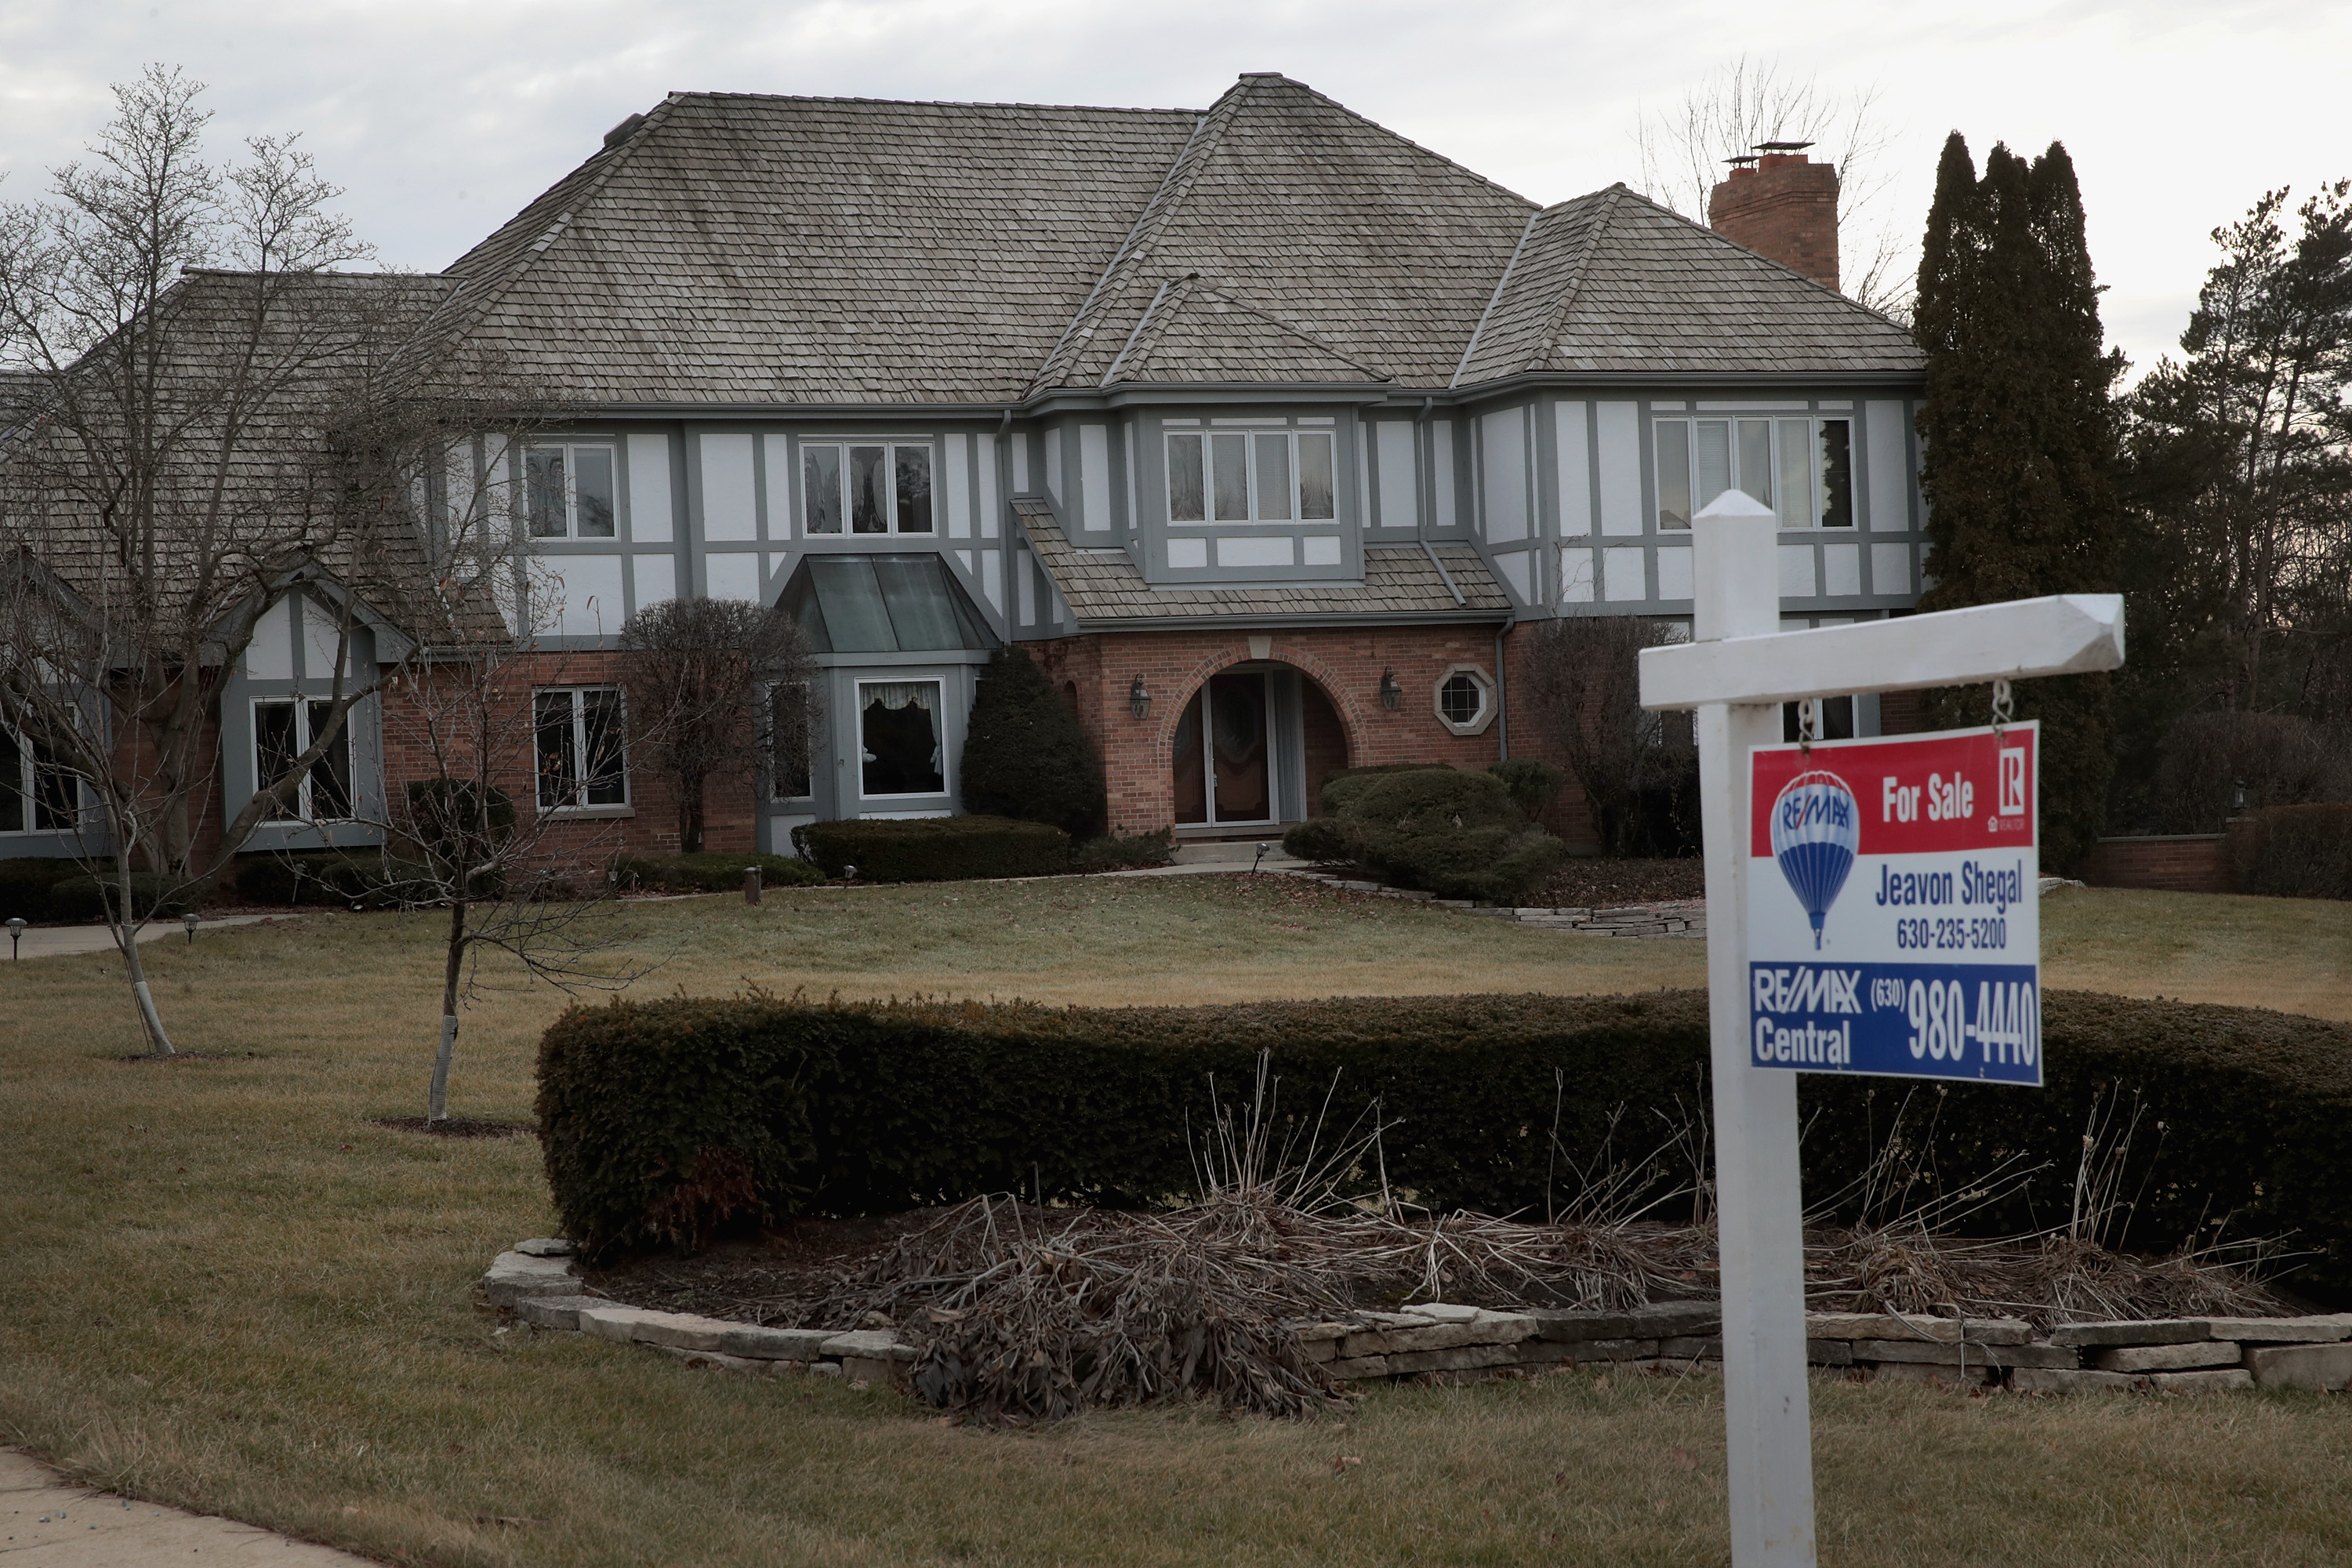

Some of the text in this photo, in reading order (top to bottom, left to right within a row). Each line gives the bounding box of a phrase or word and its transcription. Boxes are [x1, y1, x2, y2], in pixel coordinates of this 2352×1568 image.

[1783, 794, 1849, 831] RE/MAX
[1883, 771, 1973, 822] For Sale
[1876, 859, 2022, 914] Jeavon Shegal
[1897, 918, 2006, 949] 630-235-5200
[1754, 966, 1862, 1014] RE/MAX
[1755, 1017, 1850, 1064] Central
[1871, 978, 2034, 1066] (630) 980-4440
